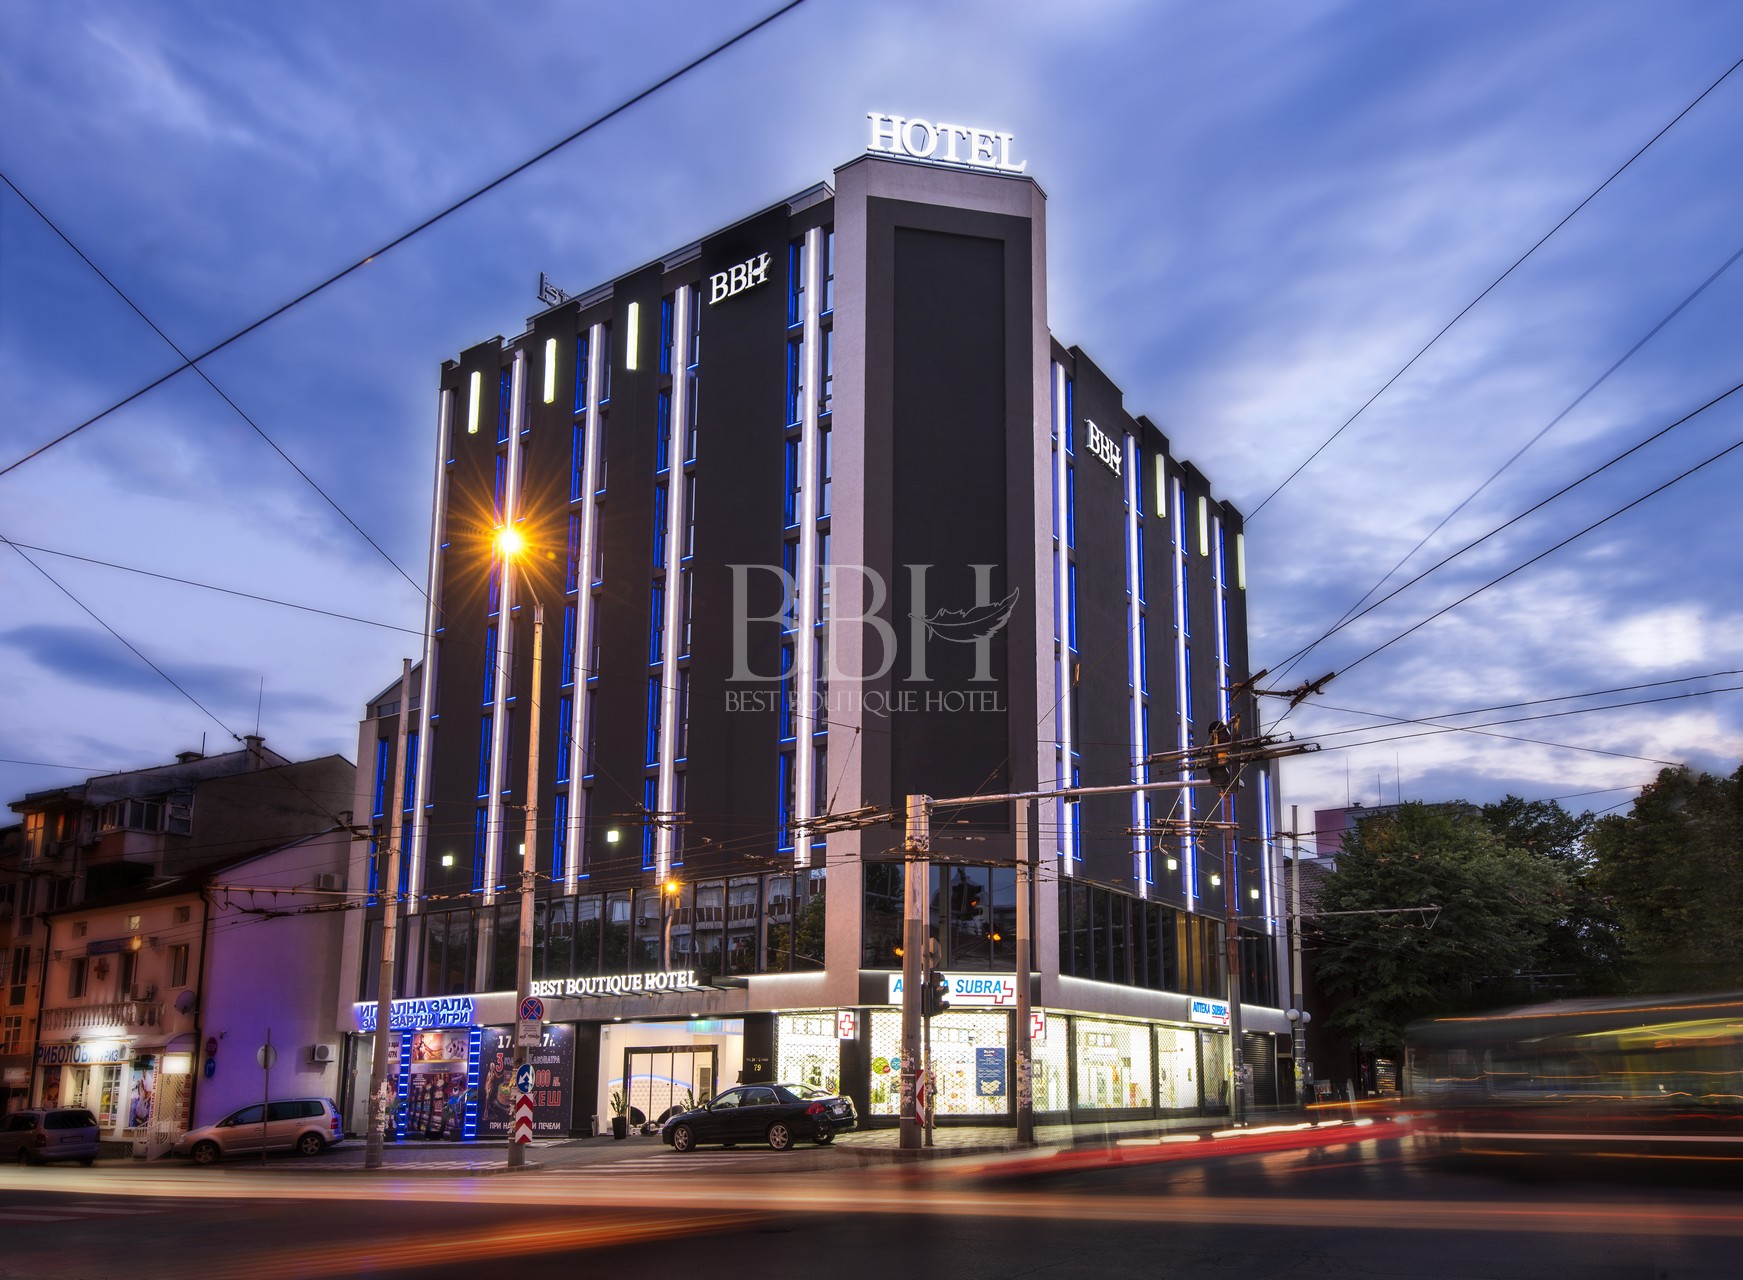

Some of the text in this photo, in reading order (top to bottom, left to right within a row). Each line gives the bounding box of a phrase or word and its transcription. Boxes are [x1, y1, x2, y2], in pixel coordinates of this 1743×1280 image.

[867, 112, 1027, 173] HOTEL
[708, 252, 771, 305] BBH
[1084, 418, 1122, 476] BBH
[530, 970, 698, 997] BEST BOUTIQUE HOTEL
[955, 979, 1002, 994] SUBRA
[360, 997, 474, 1018] ИГАЛНА ЗАЛА
[438, 1012, 470, 1025] ИГРИ
[495, 1052, 504, 1072] 3
[538, 1122, 561, 1130] ПЕЧЕЛИ
